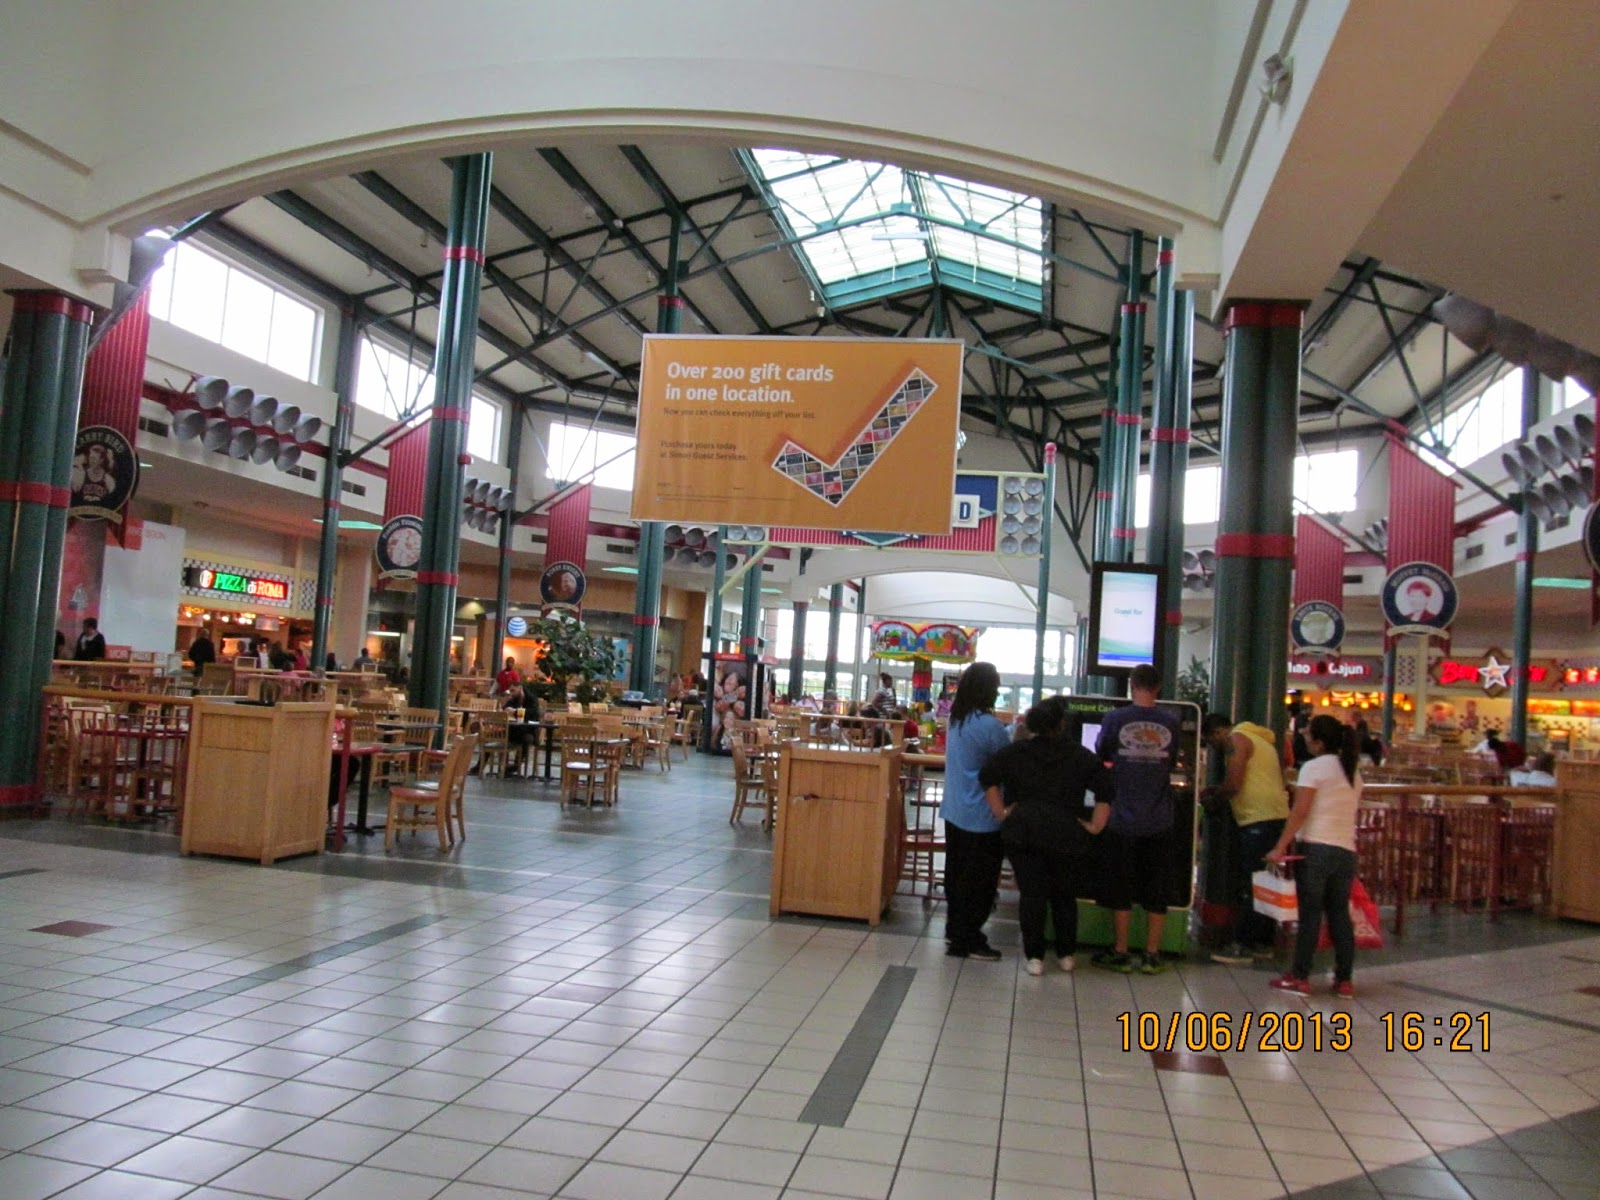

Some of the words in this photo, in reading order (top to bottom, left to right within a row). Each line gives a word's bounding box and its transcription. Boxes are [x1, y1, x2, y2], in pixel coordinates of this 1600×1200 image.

[667, 362, 707, 379] Over
[712, 366, 745, 380] 200
[750, 363, 781, 383] gift
[786, 365, 834, 381] cards
[665, 383, 681, 400] in
[686, 388, 718, 401] one
[722, 384, 795, 403] location.
[663, 407, 679, 416] Now
[680, 409, 694, 418] you
[710, 408, 730, 417] check
[732, 410, 771, 419] everything
[772, 410, 783, 418] off
[785, 411, 800, 419] your
[660, 440, 693, 449] Purchase
[695, 442, 715, 451] yours
[716, 442, 737, 451] today
[669, 450, 692, 459] Simon
[693, 451, 714, 460] Guest
[213, 572, 247, 593] PIZZA
[256, 580, 284, 598] ROMA
